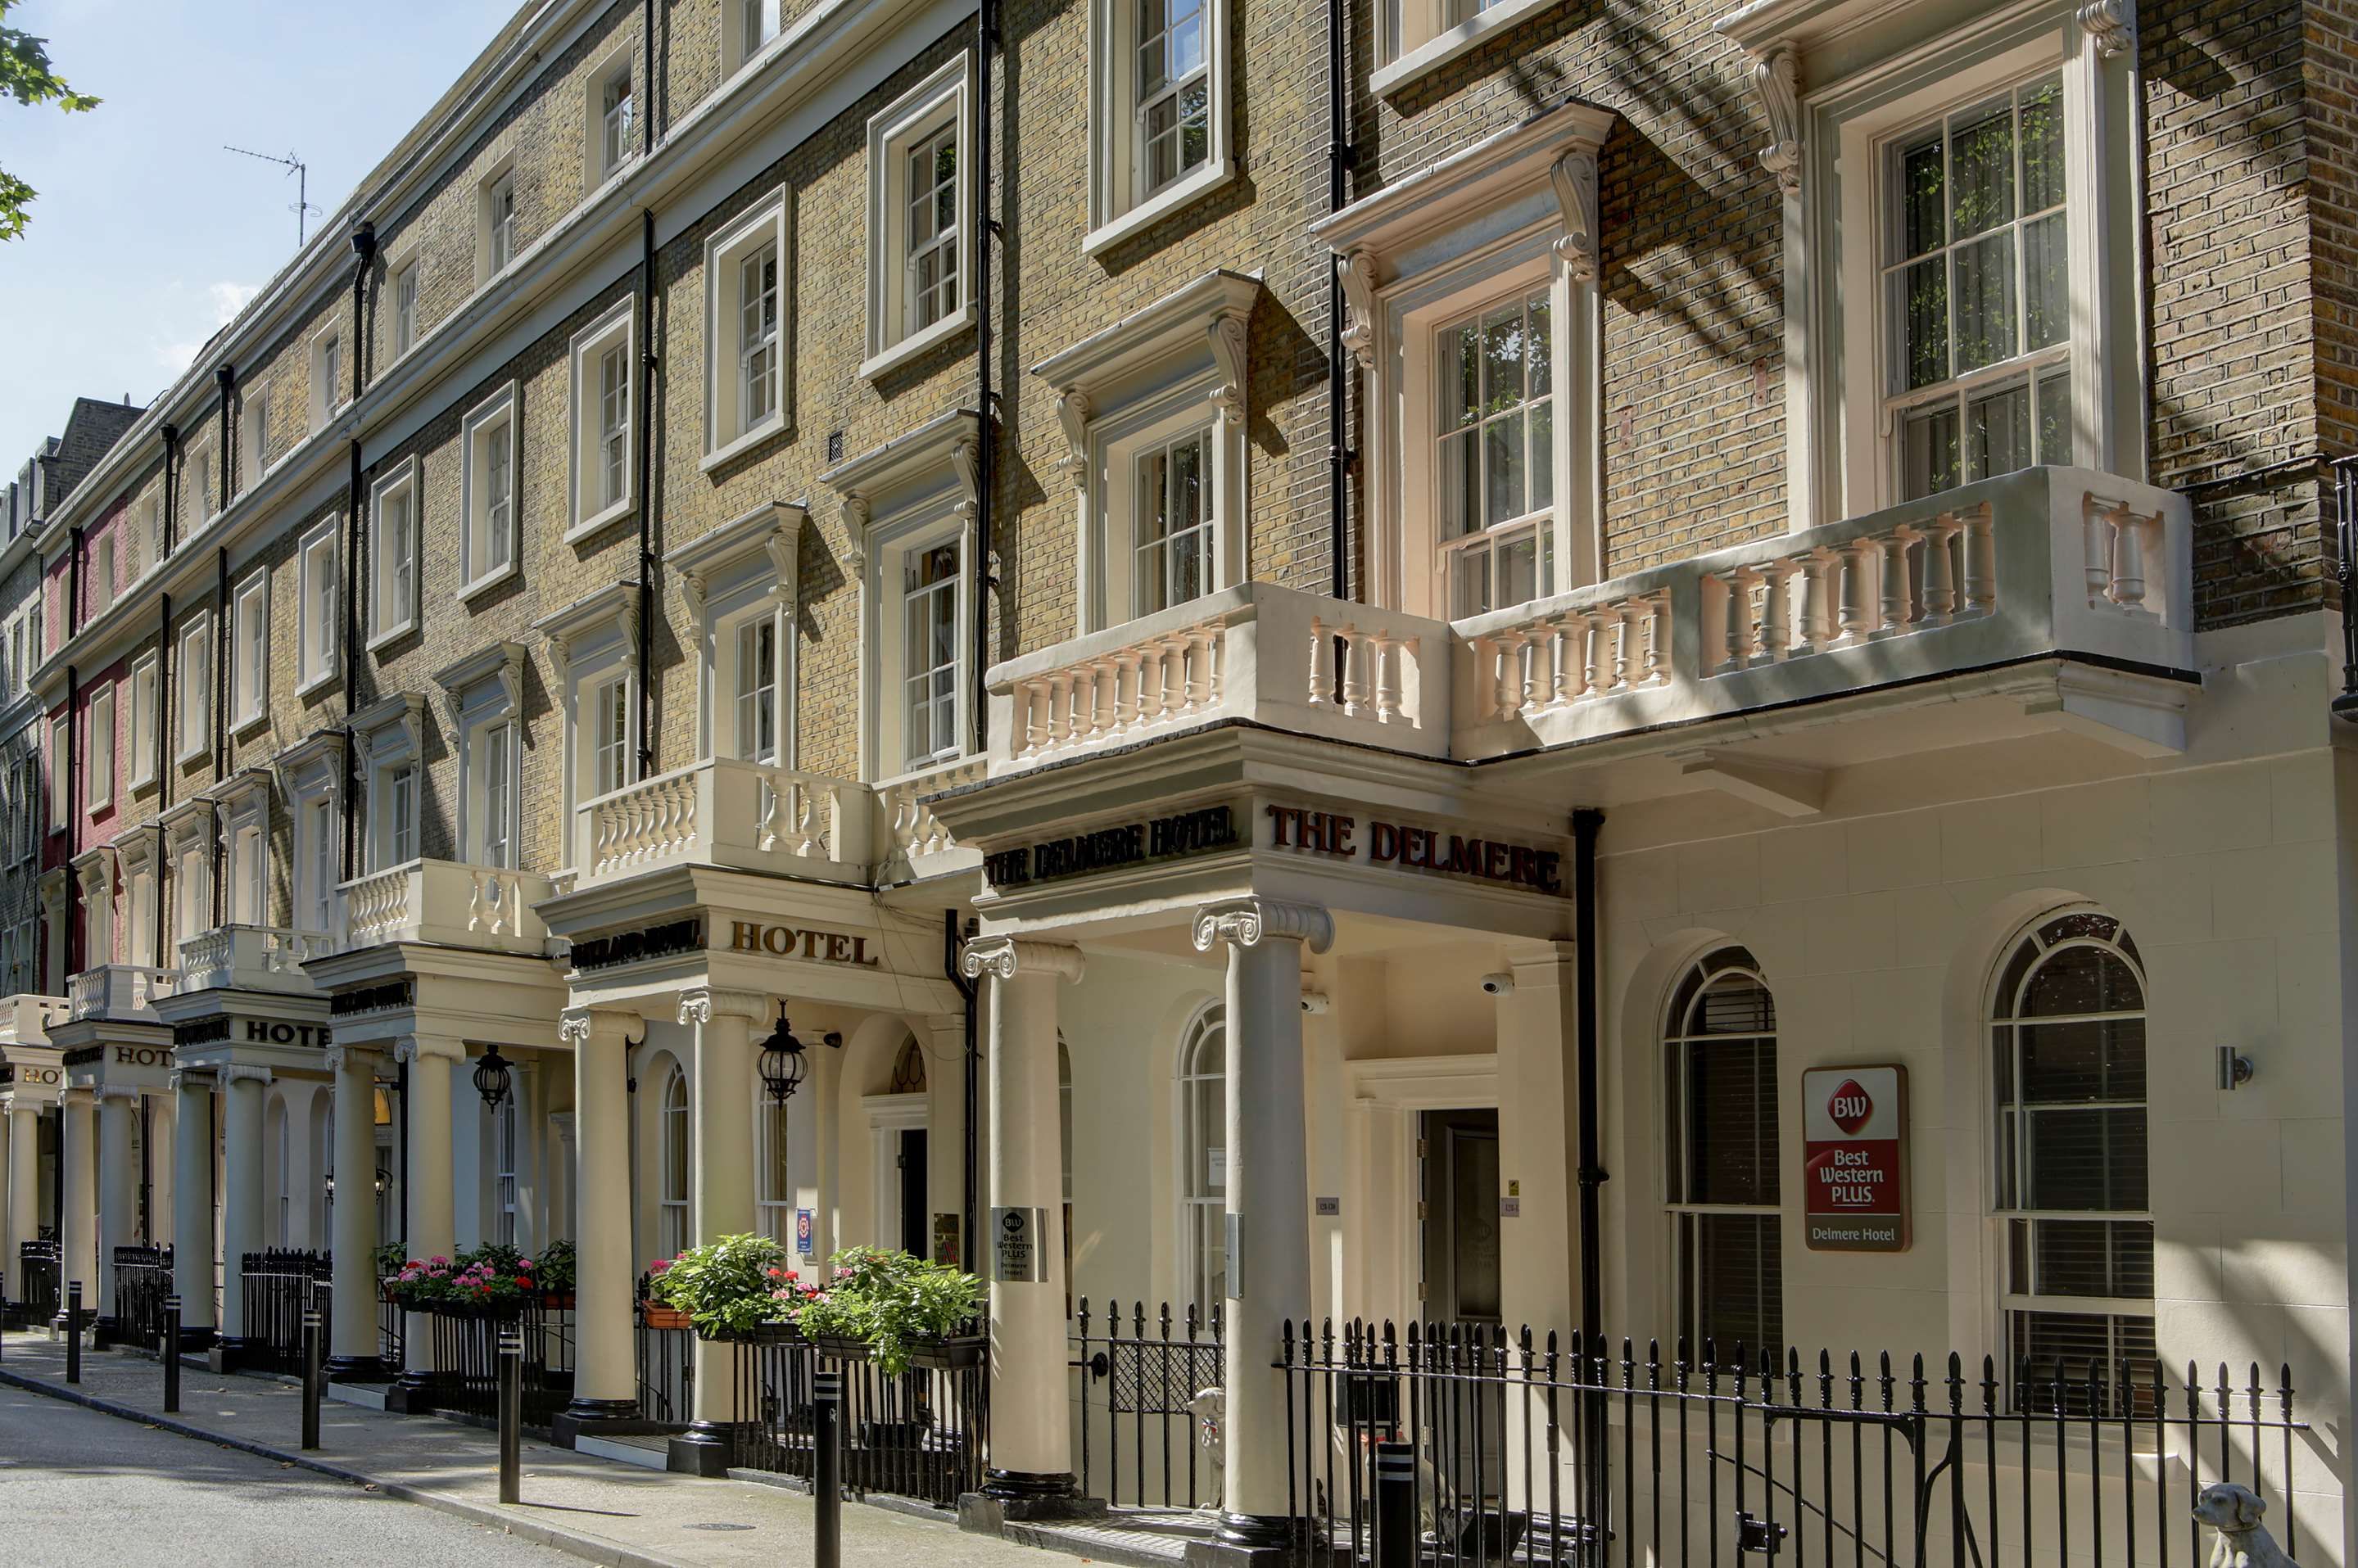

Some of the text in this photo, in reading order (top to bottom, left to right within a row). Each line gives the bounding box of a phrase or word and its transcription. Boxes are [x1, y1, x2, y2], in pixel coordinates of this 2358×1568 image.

[1265, 804, 1562, 892] THE DELMERE
[731, 920, 879, 967] HOTEL
[247, 1020, 333, 1049] HOTE
[115, 1046, 174, 1066] HOT
[1834, 1096, 1867, 1118] BW
[1834, 1149, 1869, 1166] Best
[1820, 1167, 1885, 1183] Western
[1831, 1186, 1872, 1203] PLUS
[1004, 1218, 1023, 1227] BW
[1003, 1234, 1023, 1242] Best
[1813, 1227, 1895, 1241] Delmere Hotel
[997, 1241, 1033, 1249] Western
[1002, 1249, 1025, 1258] PLUS
